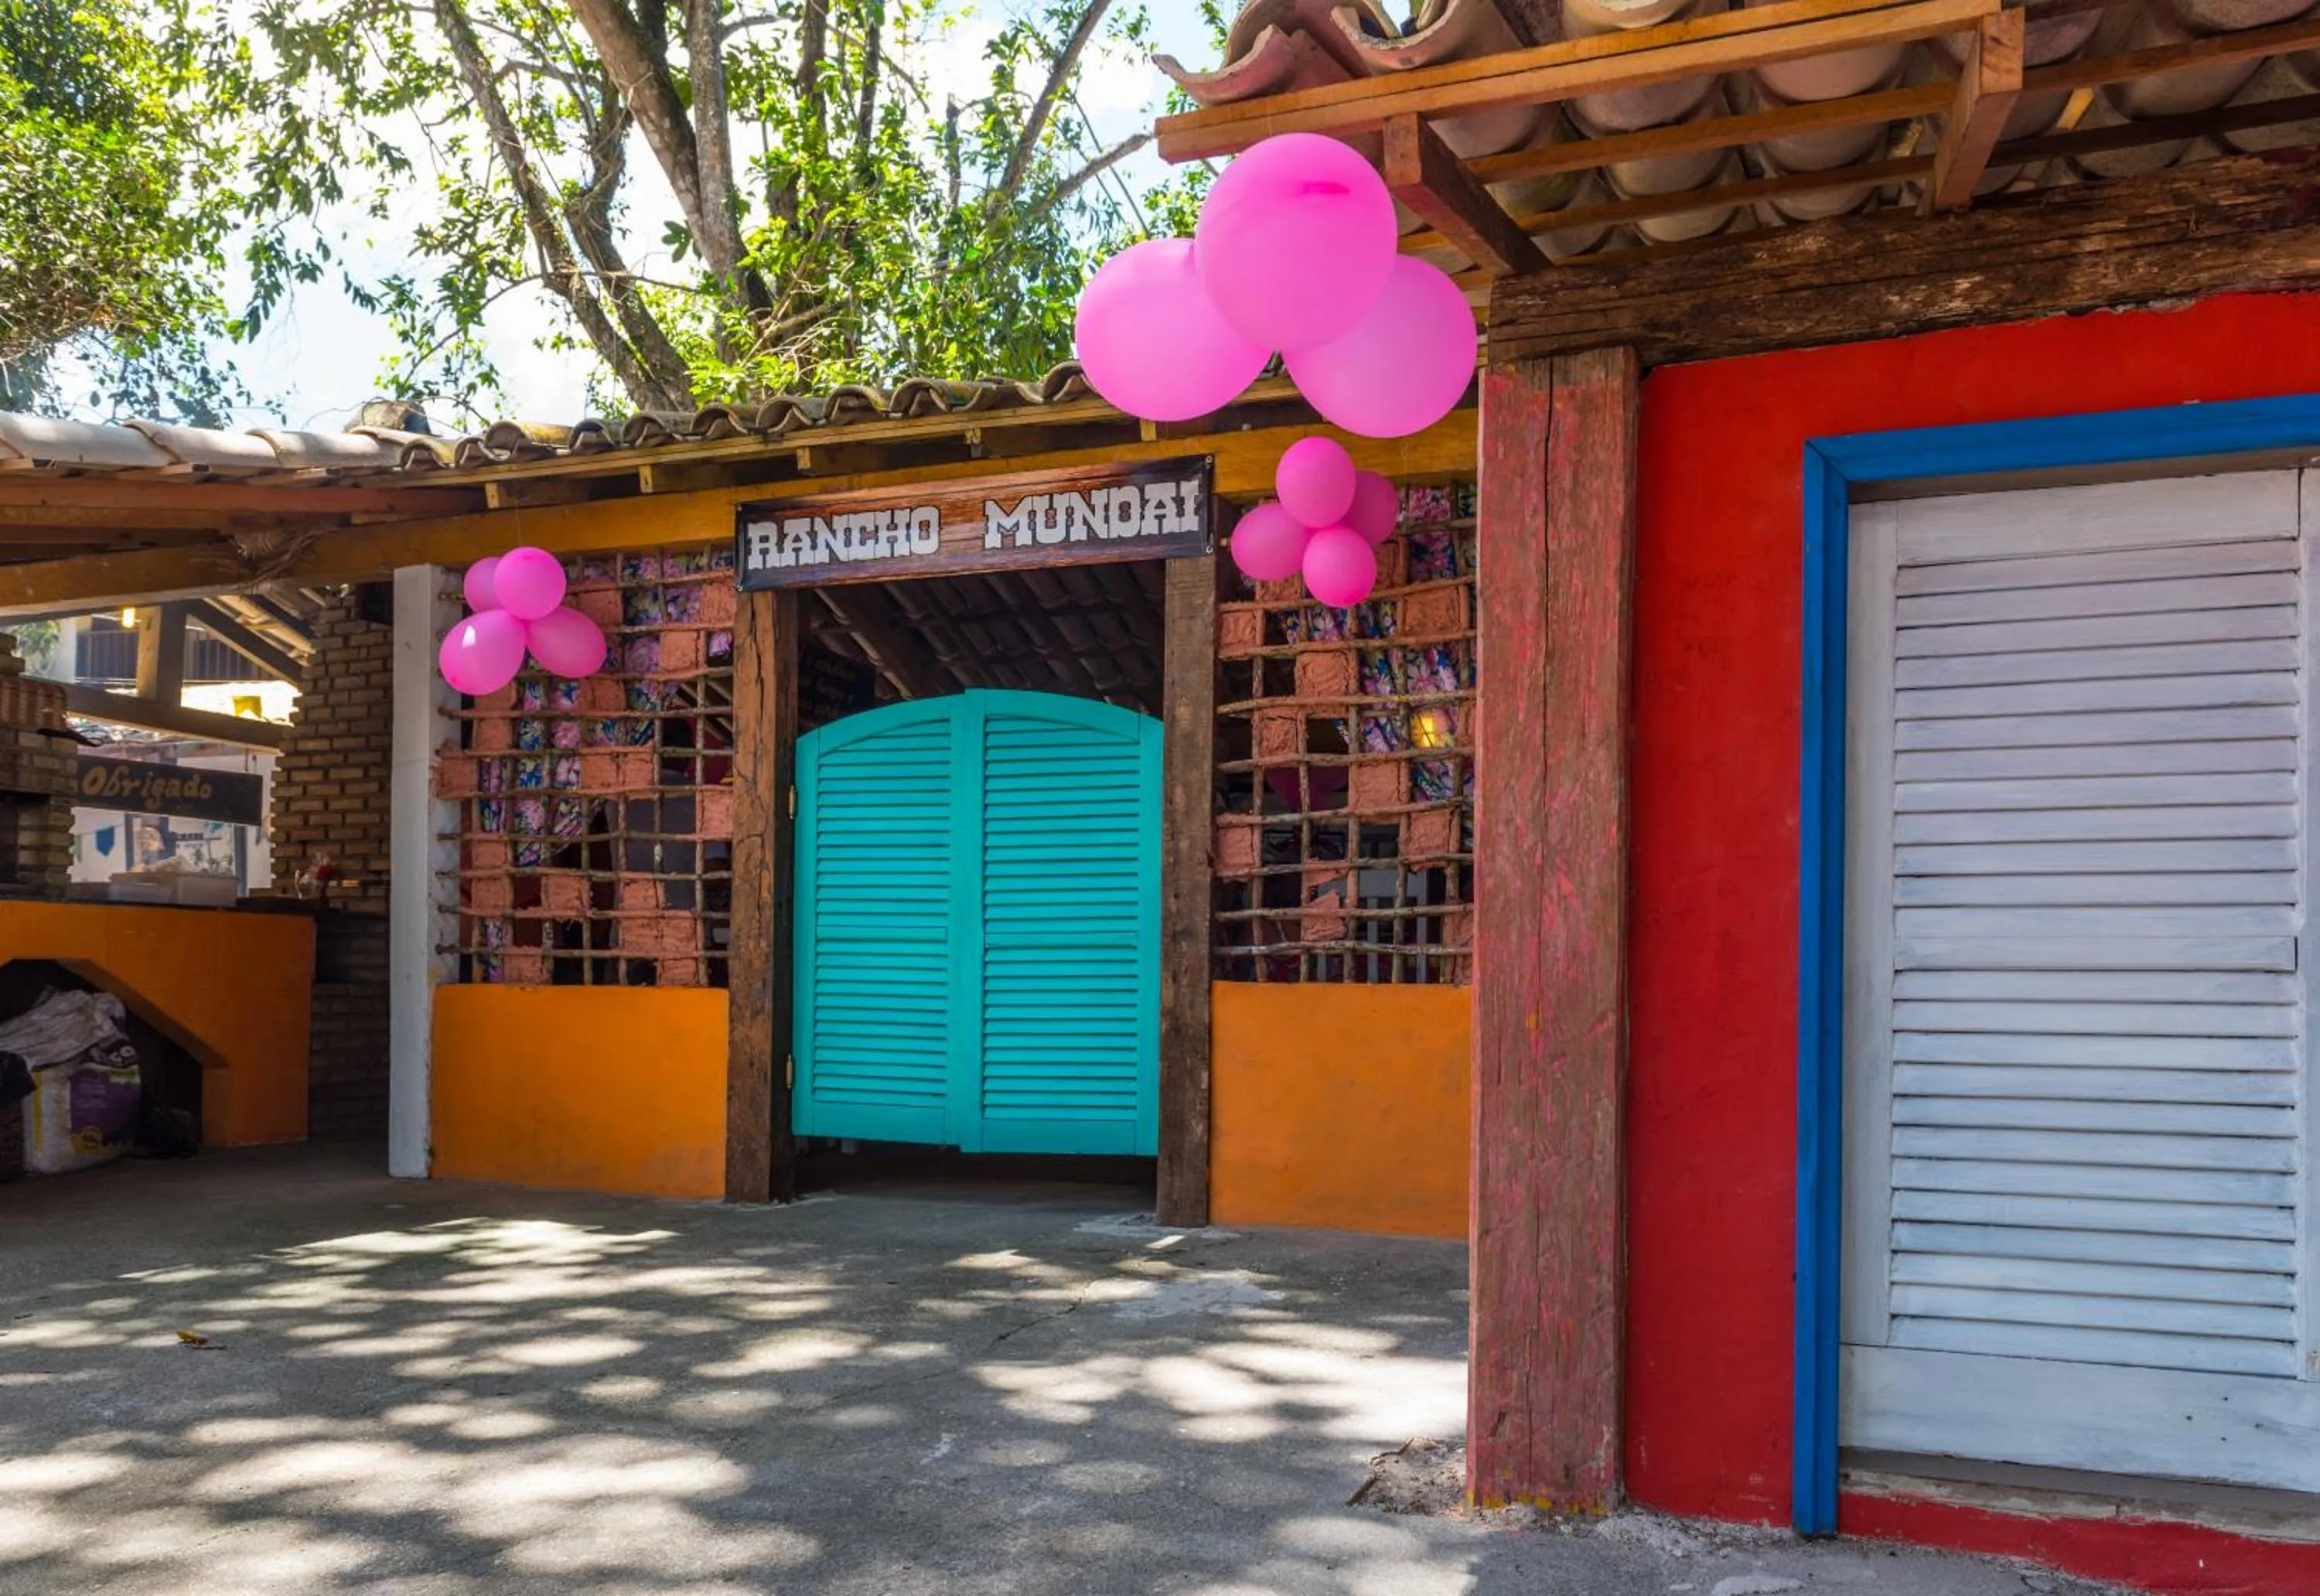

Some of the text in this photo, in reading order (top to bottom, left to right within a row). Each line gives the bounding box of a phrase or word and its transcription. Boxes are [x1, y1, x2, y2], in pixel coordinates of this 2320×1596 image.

[747, 480, 1199, 569] RANCHO MUNDAI
[83, 765, 211, 809] Obrigado
